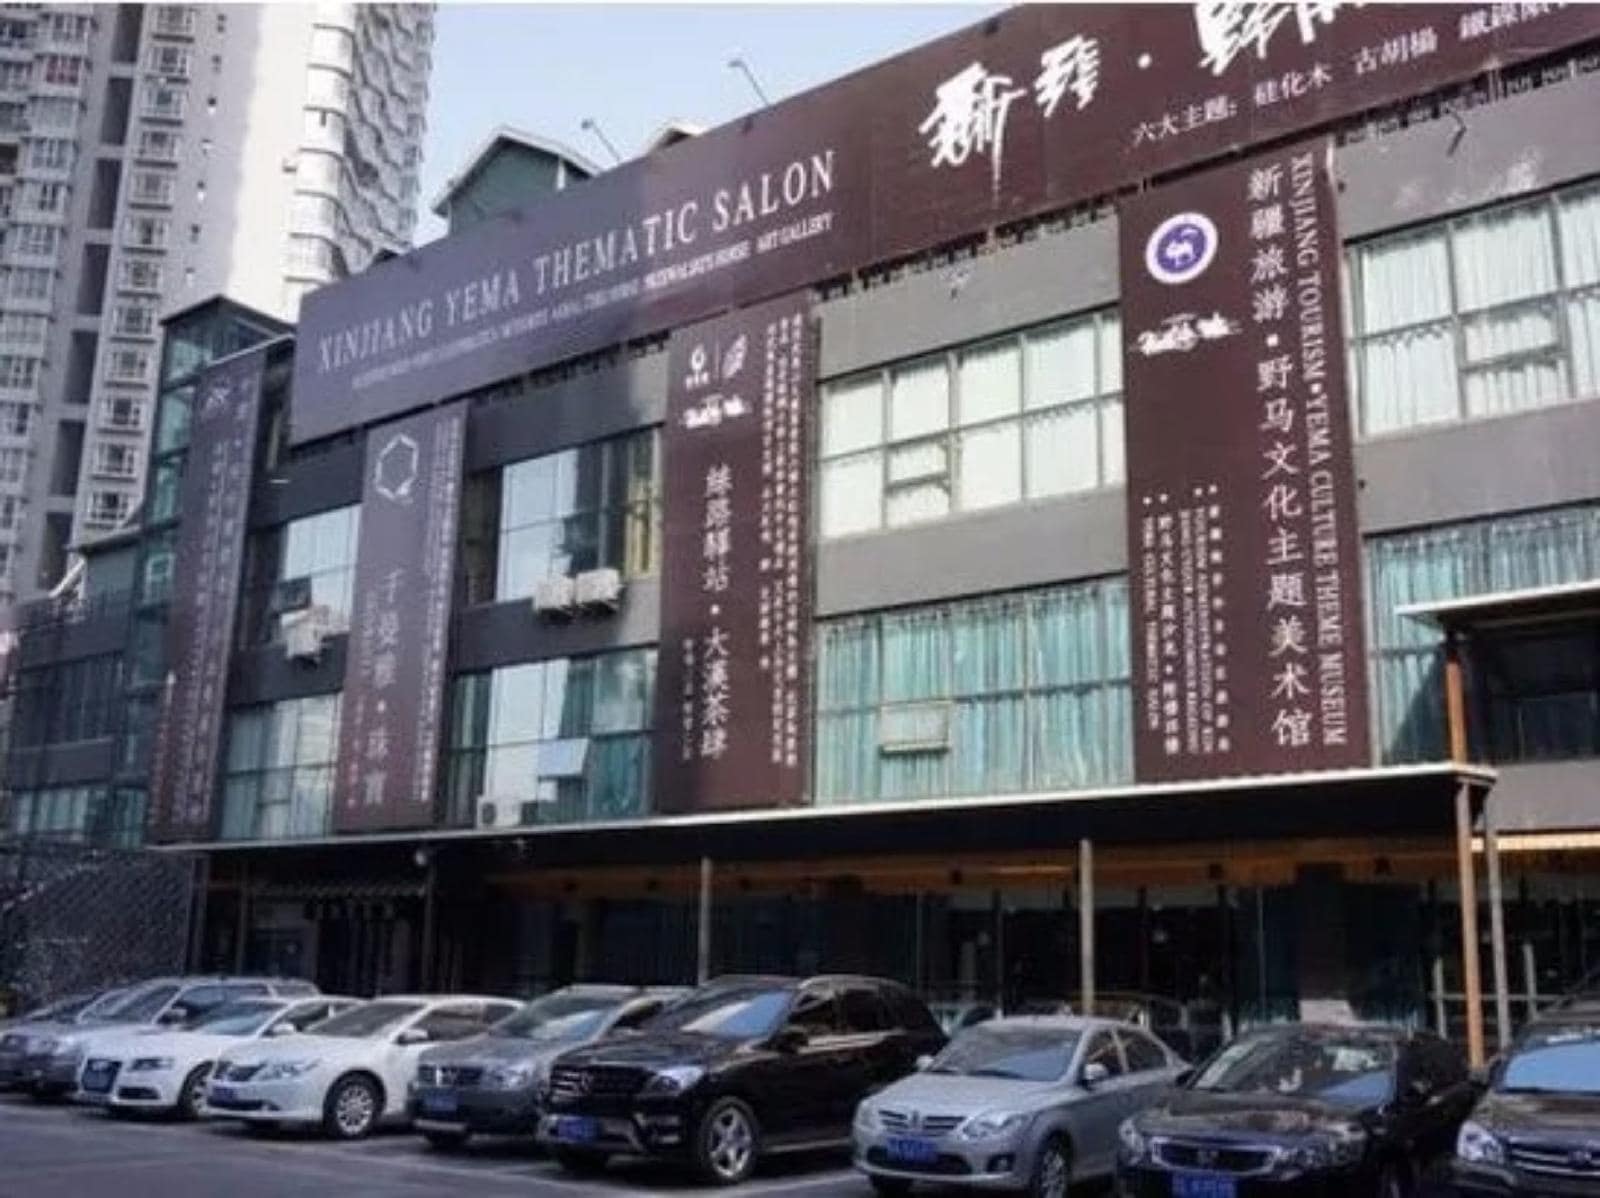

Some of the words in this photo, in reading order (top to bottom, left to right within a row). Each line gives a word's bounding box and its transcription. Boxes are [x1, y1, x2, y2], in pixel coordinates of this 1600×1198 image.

[1291, 152, 1319, 267] XINJIANG
[318, 300, 433, 374] XINJIANG
[443, 267, 520, 325] YEMA
[533, 200, 698, 296] THEMATIC
[712, 149, 835, 233] SALON
[1309, 470, 1339, 567] CULTURE
[1314, 568, 1344, 646] THEME
[1319, 653, 1348, 746] MUSEUM
